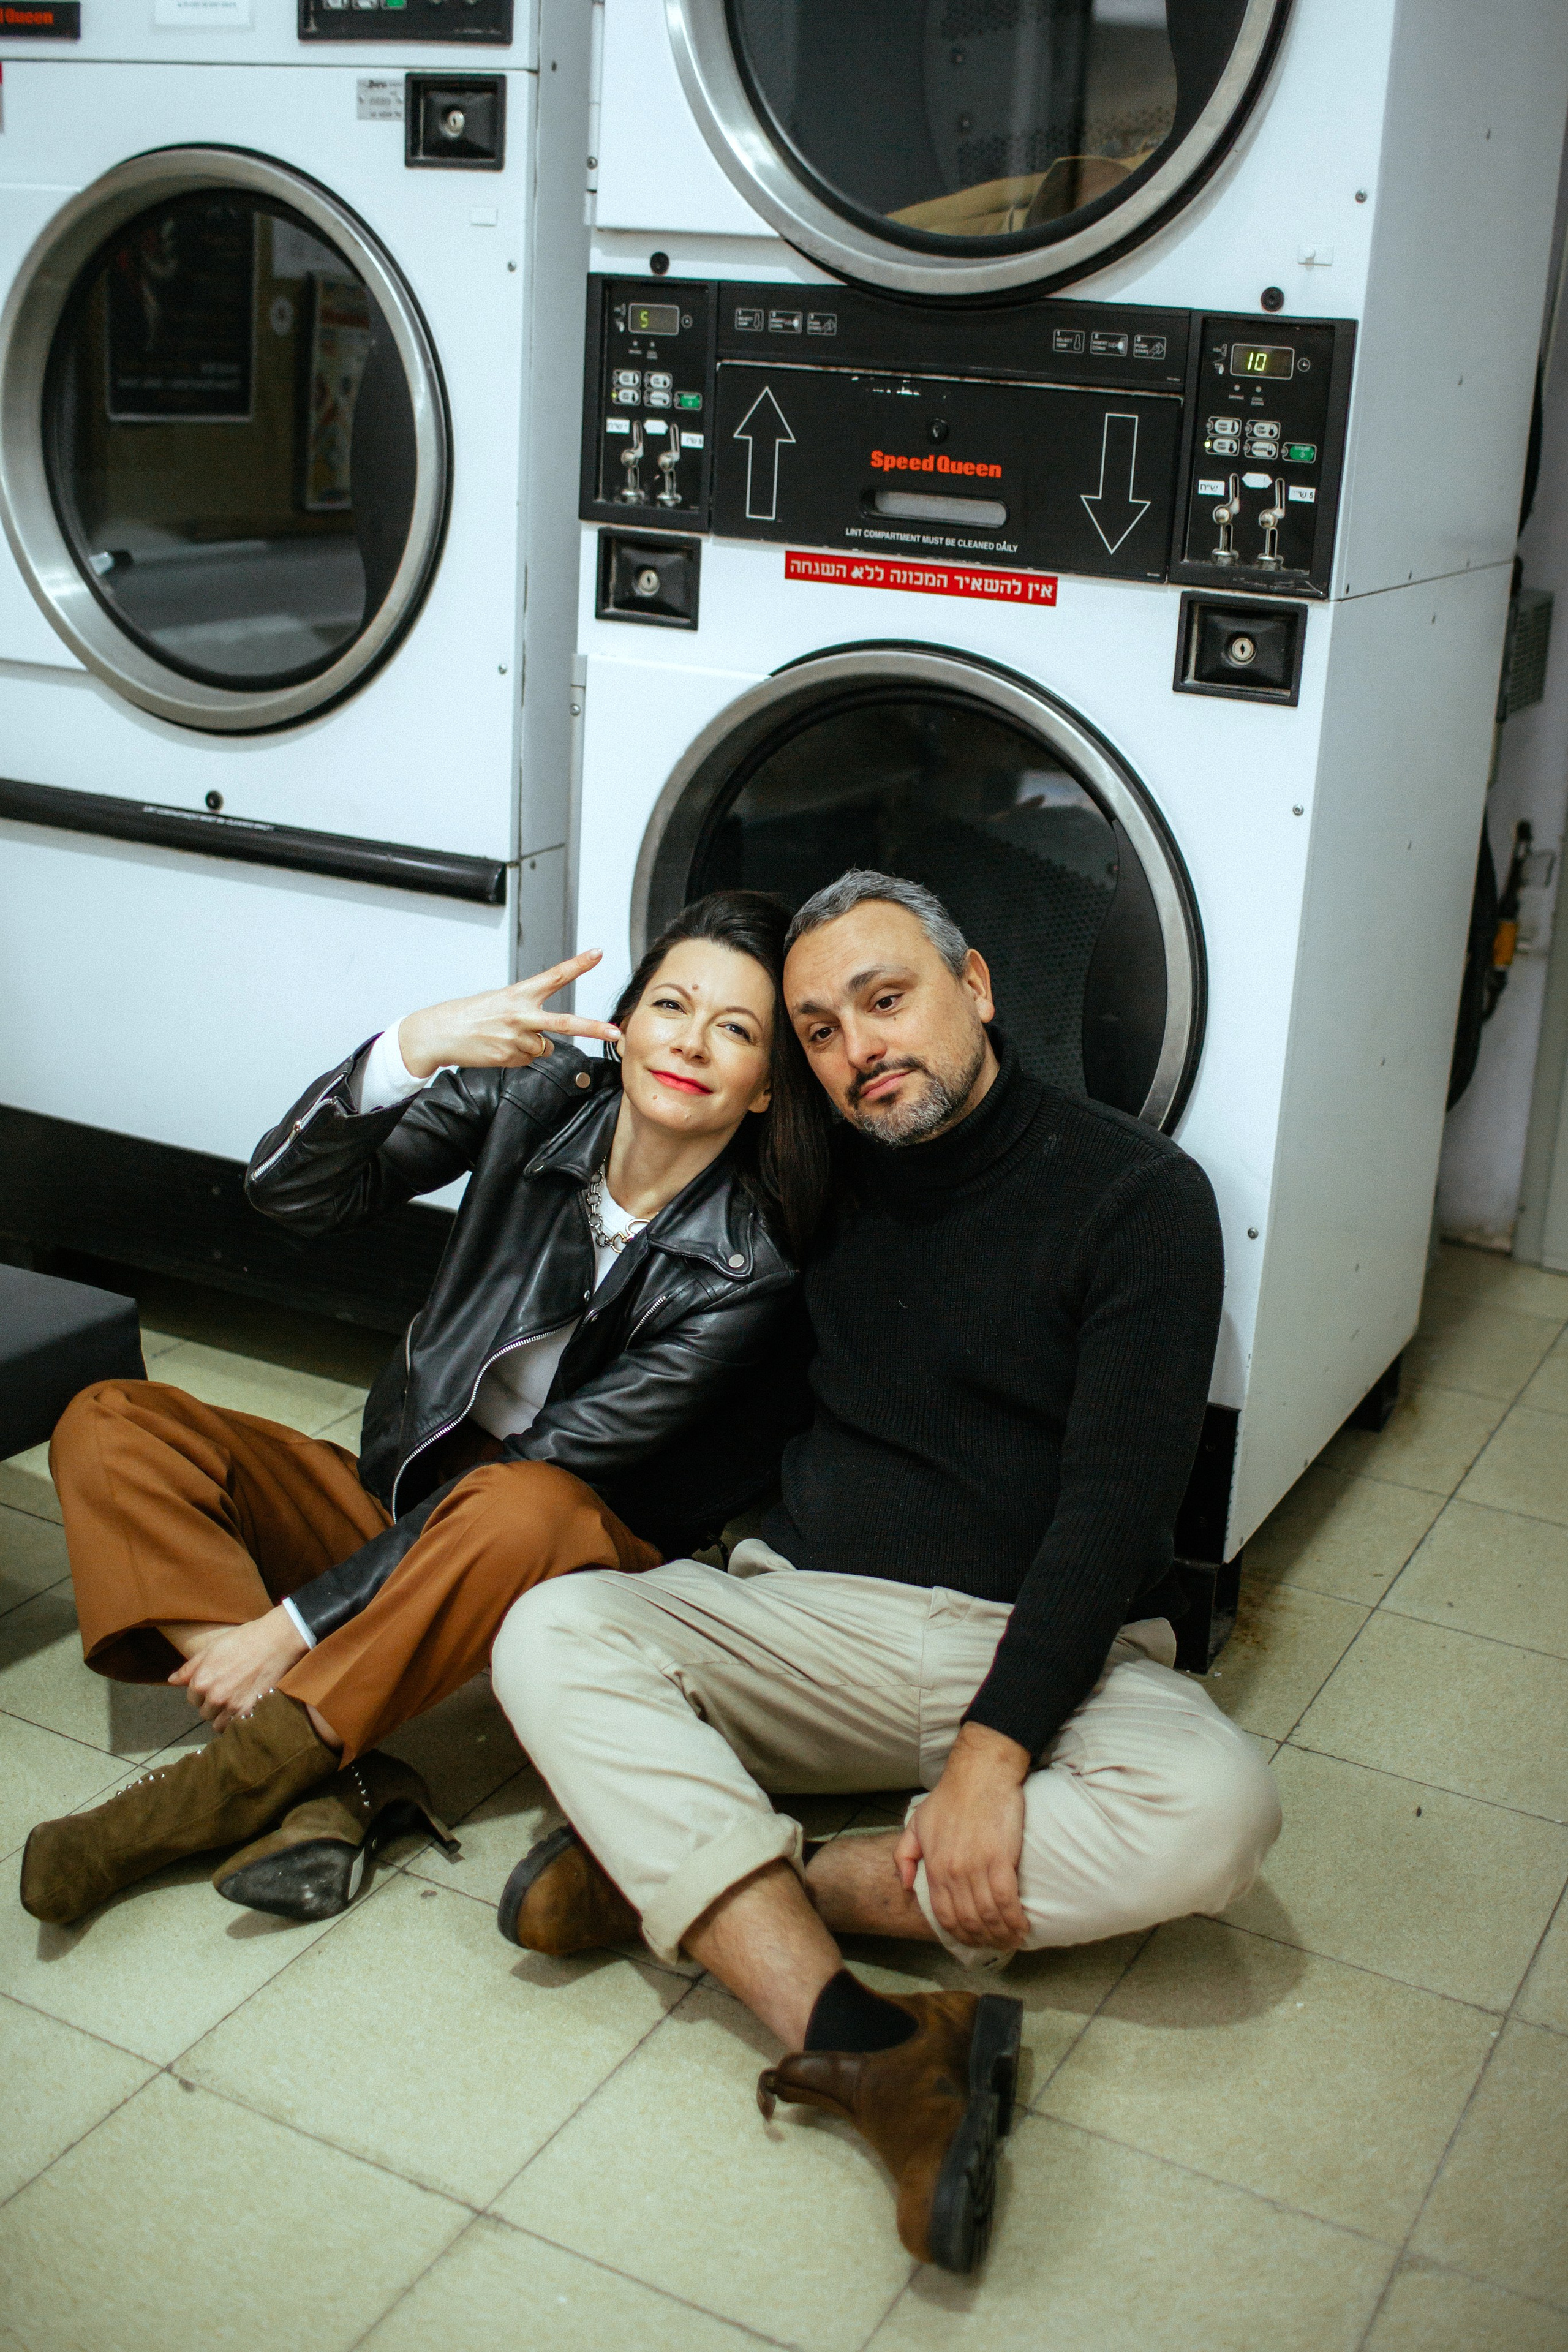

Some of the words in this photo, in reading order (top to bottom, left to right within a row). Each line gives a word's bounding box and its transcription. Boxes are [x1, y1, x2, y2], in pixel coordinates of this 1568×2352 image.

[639, 310, 649, 328] 5
[1247, 352, 1267, 371] 10
[870, 450, 935, 472] Speed
[937, 455, 1002, 478] Queen
[845, 527, 862, 537] LINT
[863, 529, 921, 543] COMPARTMENT
[922, 535, 944, 545] MUST
[945, 537, 956, 546] BE
[957, 539, 995, 551] CLEANED
[995, 541, 1018, 552] DAILY
[790, 559, 848, 578] השגחה
[850, 564, 884, 581] ללא
[889, 568, 948, 589] המכונה
[954, 574, 1022, 596] להשאיר
[1028, 582, 1054, 600] אין
